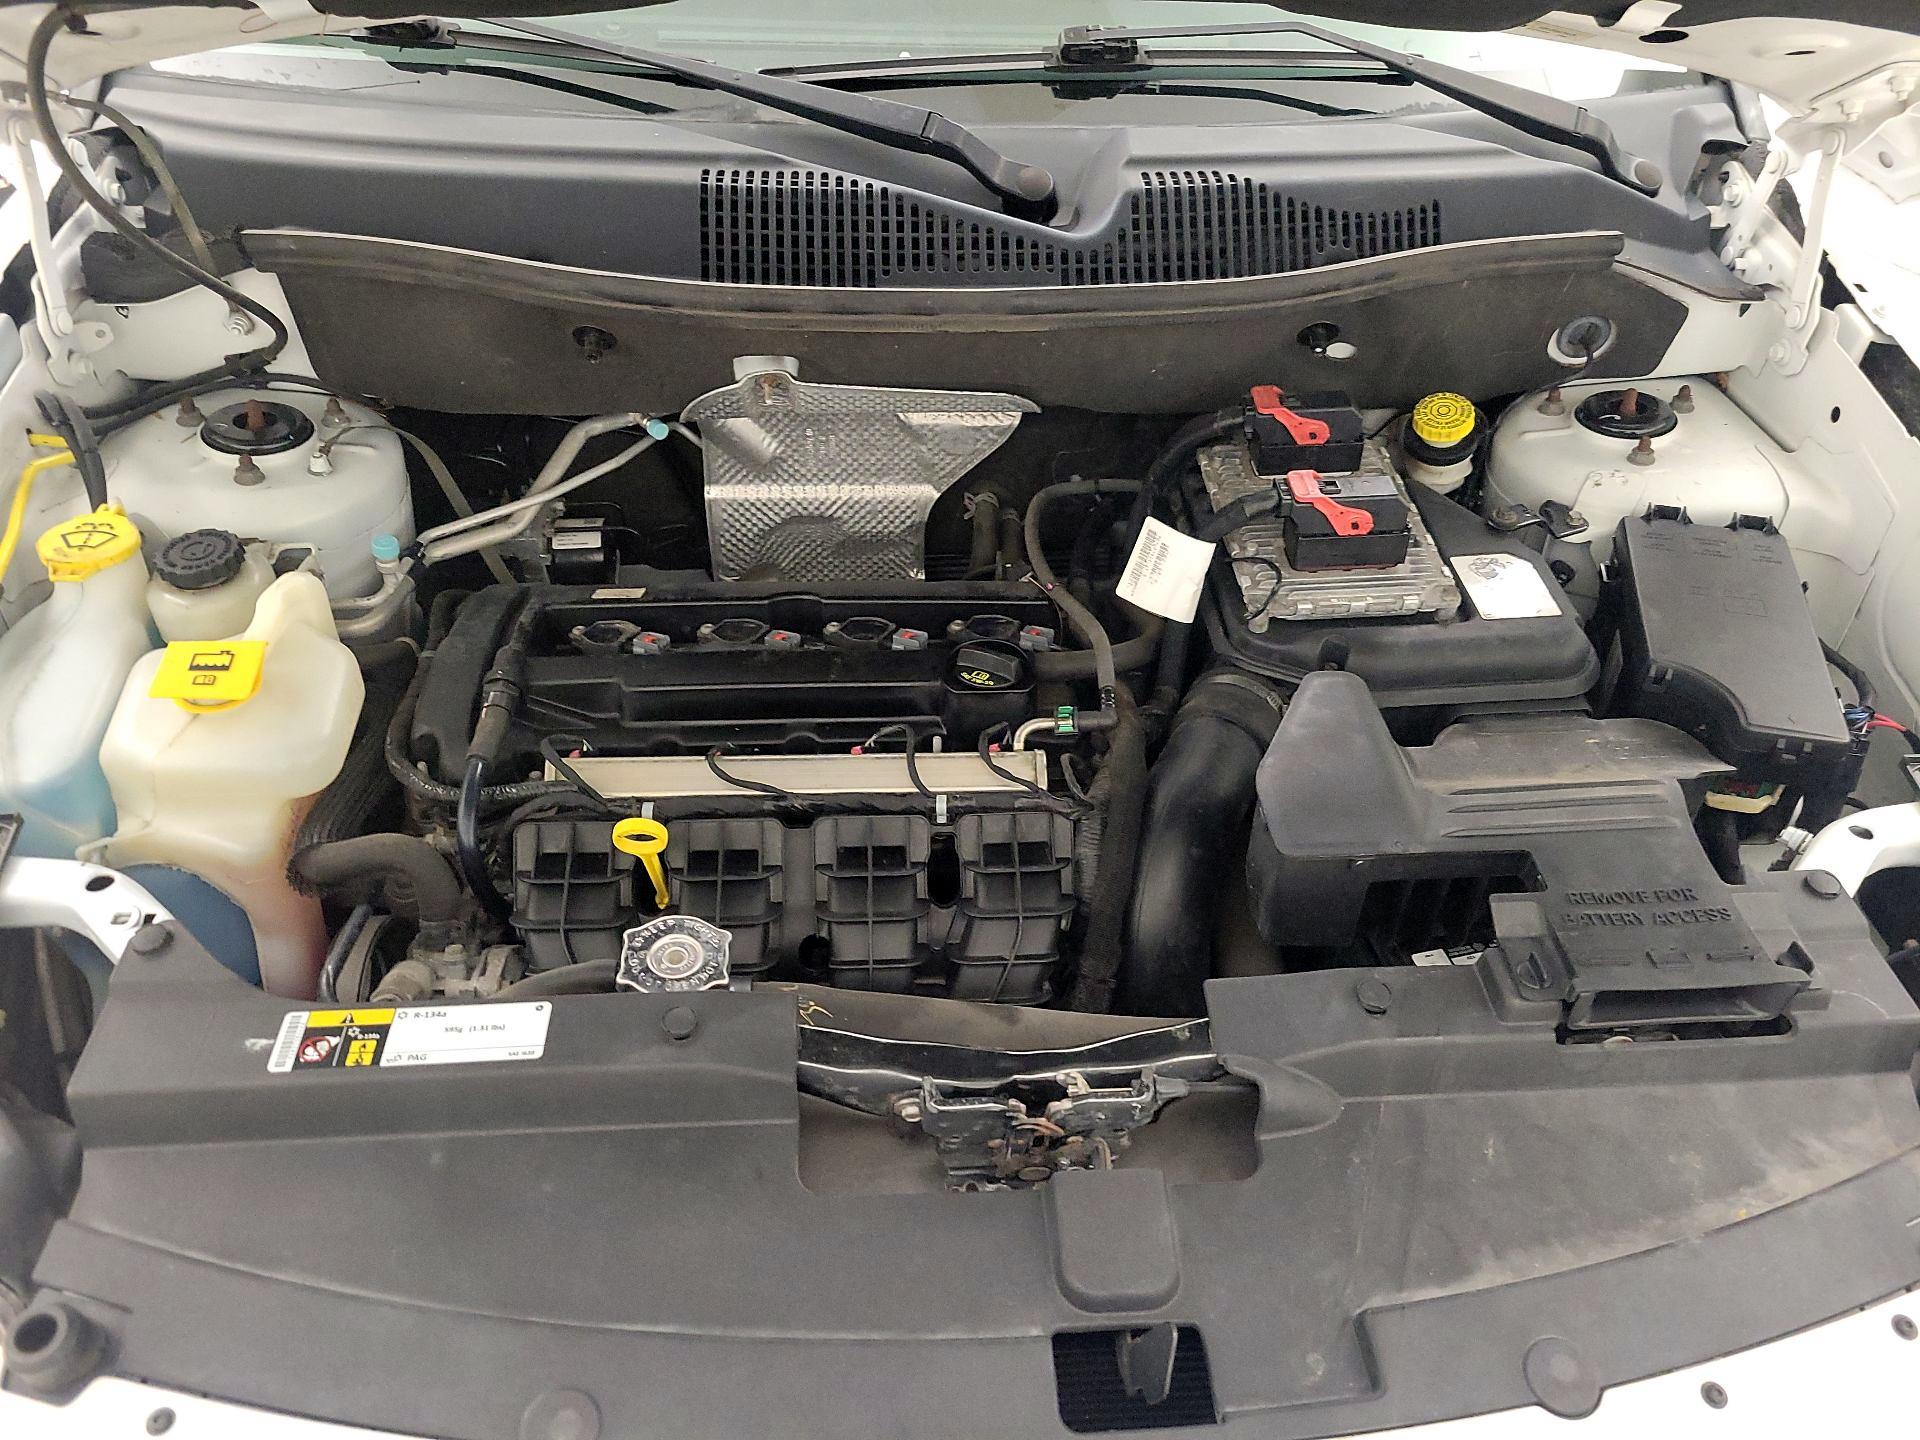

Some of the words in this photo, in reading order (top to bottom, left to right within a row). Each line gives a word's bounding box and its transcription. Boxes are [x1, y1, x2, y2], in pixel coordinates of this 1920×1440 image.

[1567, 890, 1650, 905] REMOVE
[1653, 888, 1699, 902] FOR
[1563, 911, 1646, 926] BATTERY
[1654, 907, 1732, 925] ACCESS
